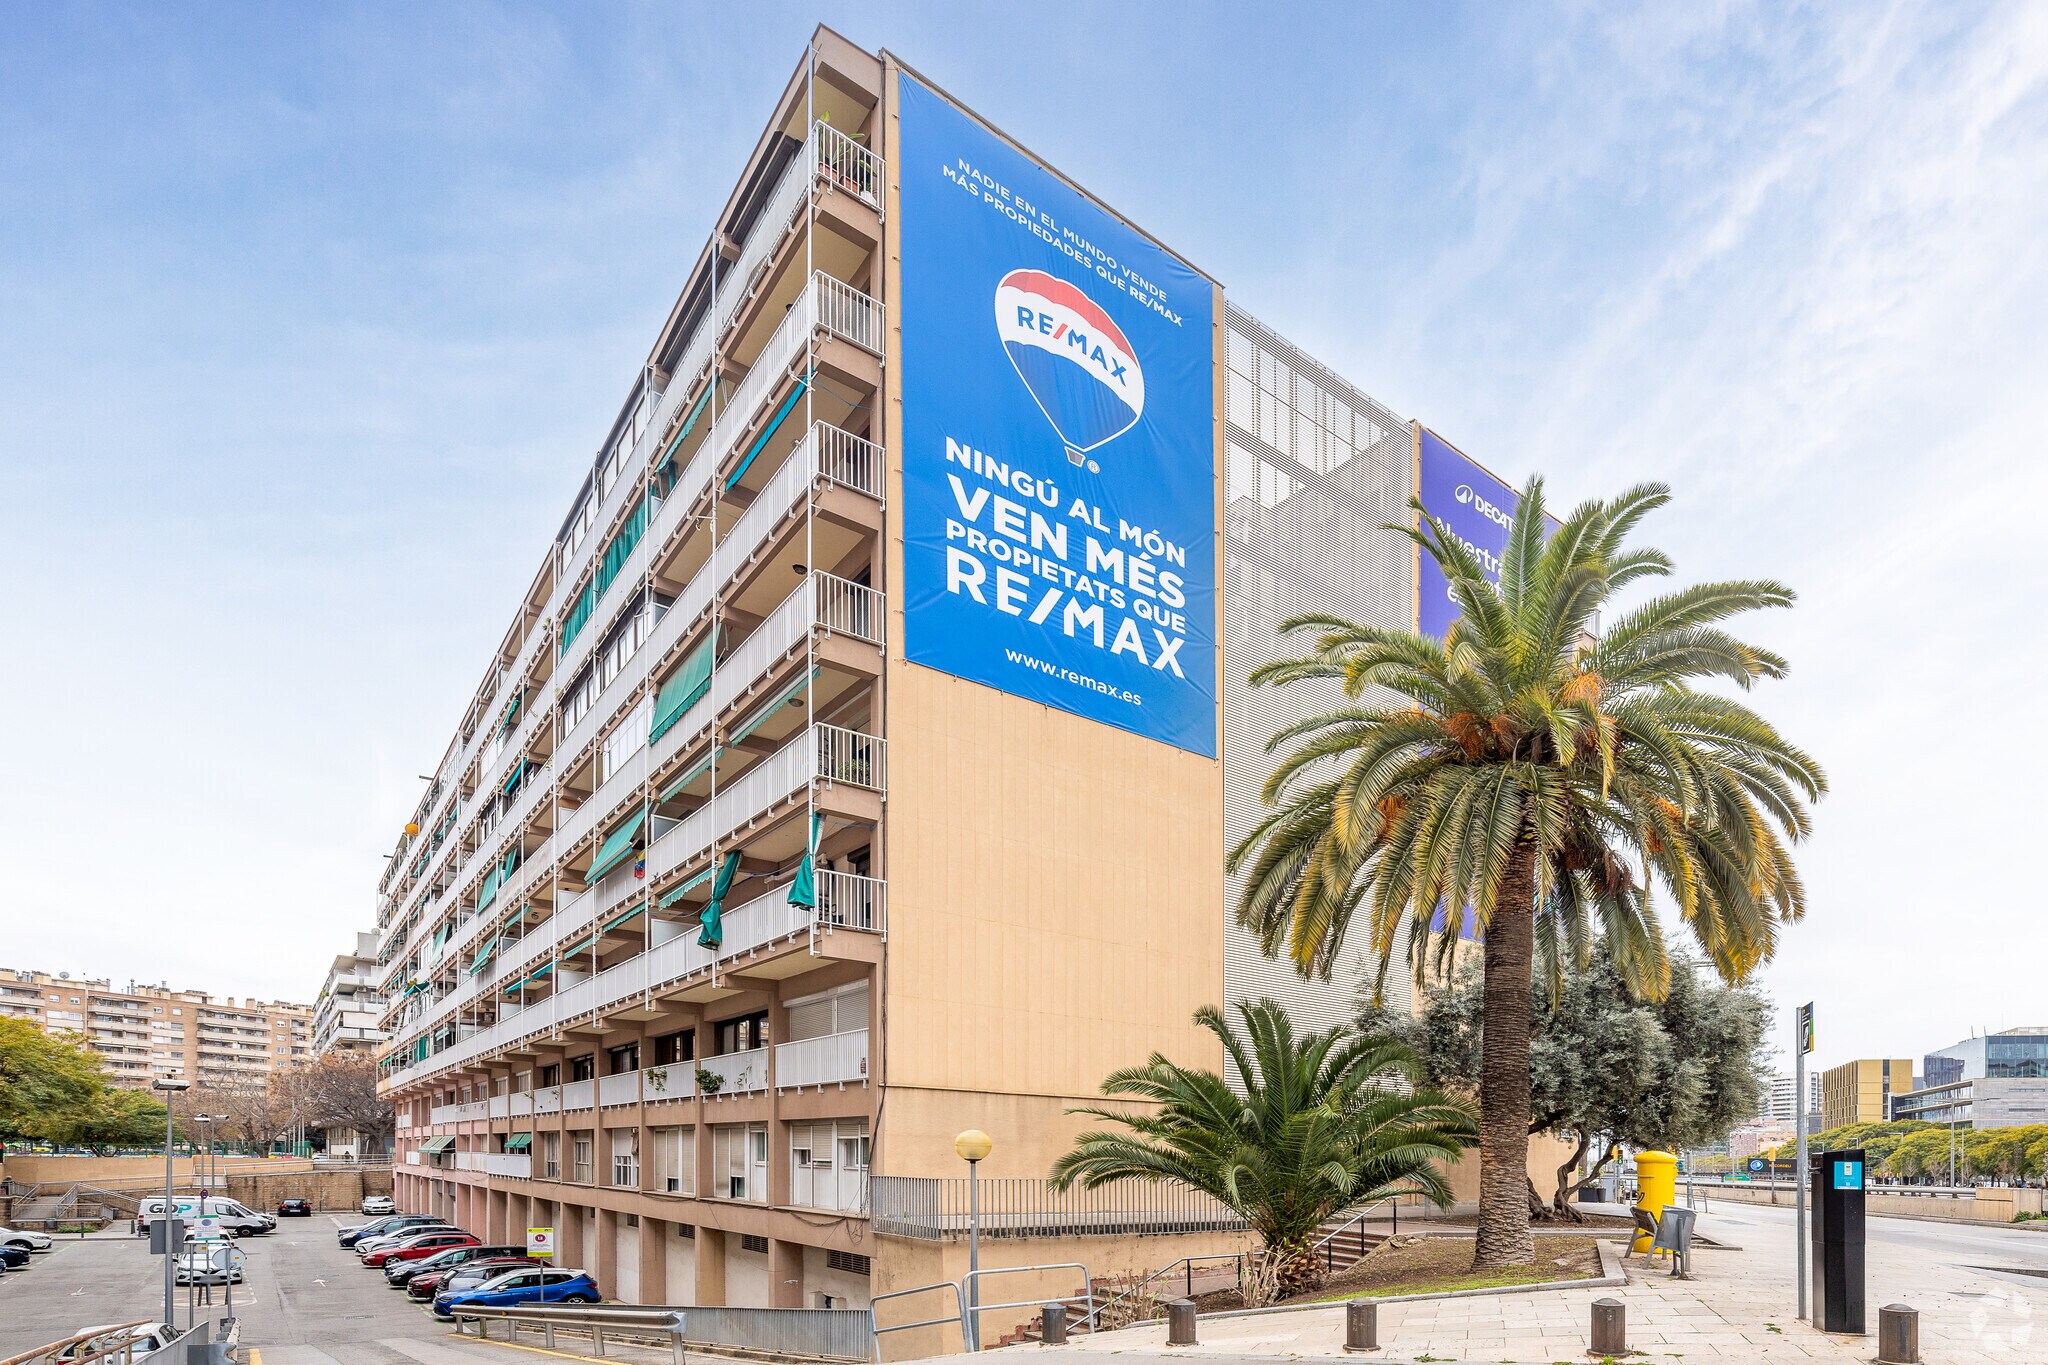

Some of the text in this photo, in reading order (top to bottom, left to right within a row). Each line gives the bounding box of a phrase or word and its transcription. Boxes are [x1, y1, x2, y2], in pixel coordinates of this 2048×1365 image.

[943, 164, 1183, 328] MÁS PROPIEDADES QUE RE/MAX
[958, 158, 1167, 303] NADIE EN EL MUNDO VENDE
[1017, 305, 1127, 387] RE/MAX
[945, 435, 1185, 569] NINGÚ AL MÓN
[946, 472, 1185, 610] VEN MÉS
[946, 518, 1186, 635] PROPIETATS QUE
[946, 545, 1186, 680] RE/MAX
[1005, 648, 1142, 706] www.remax.es
